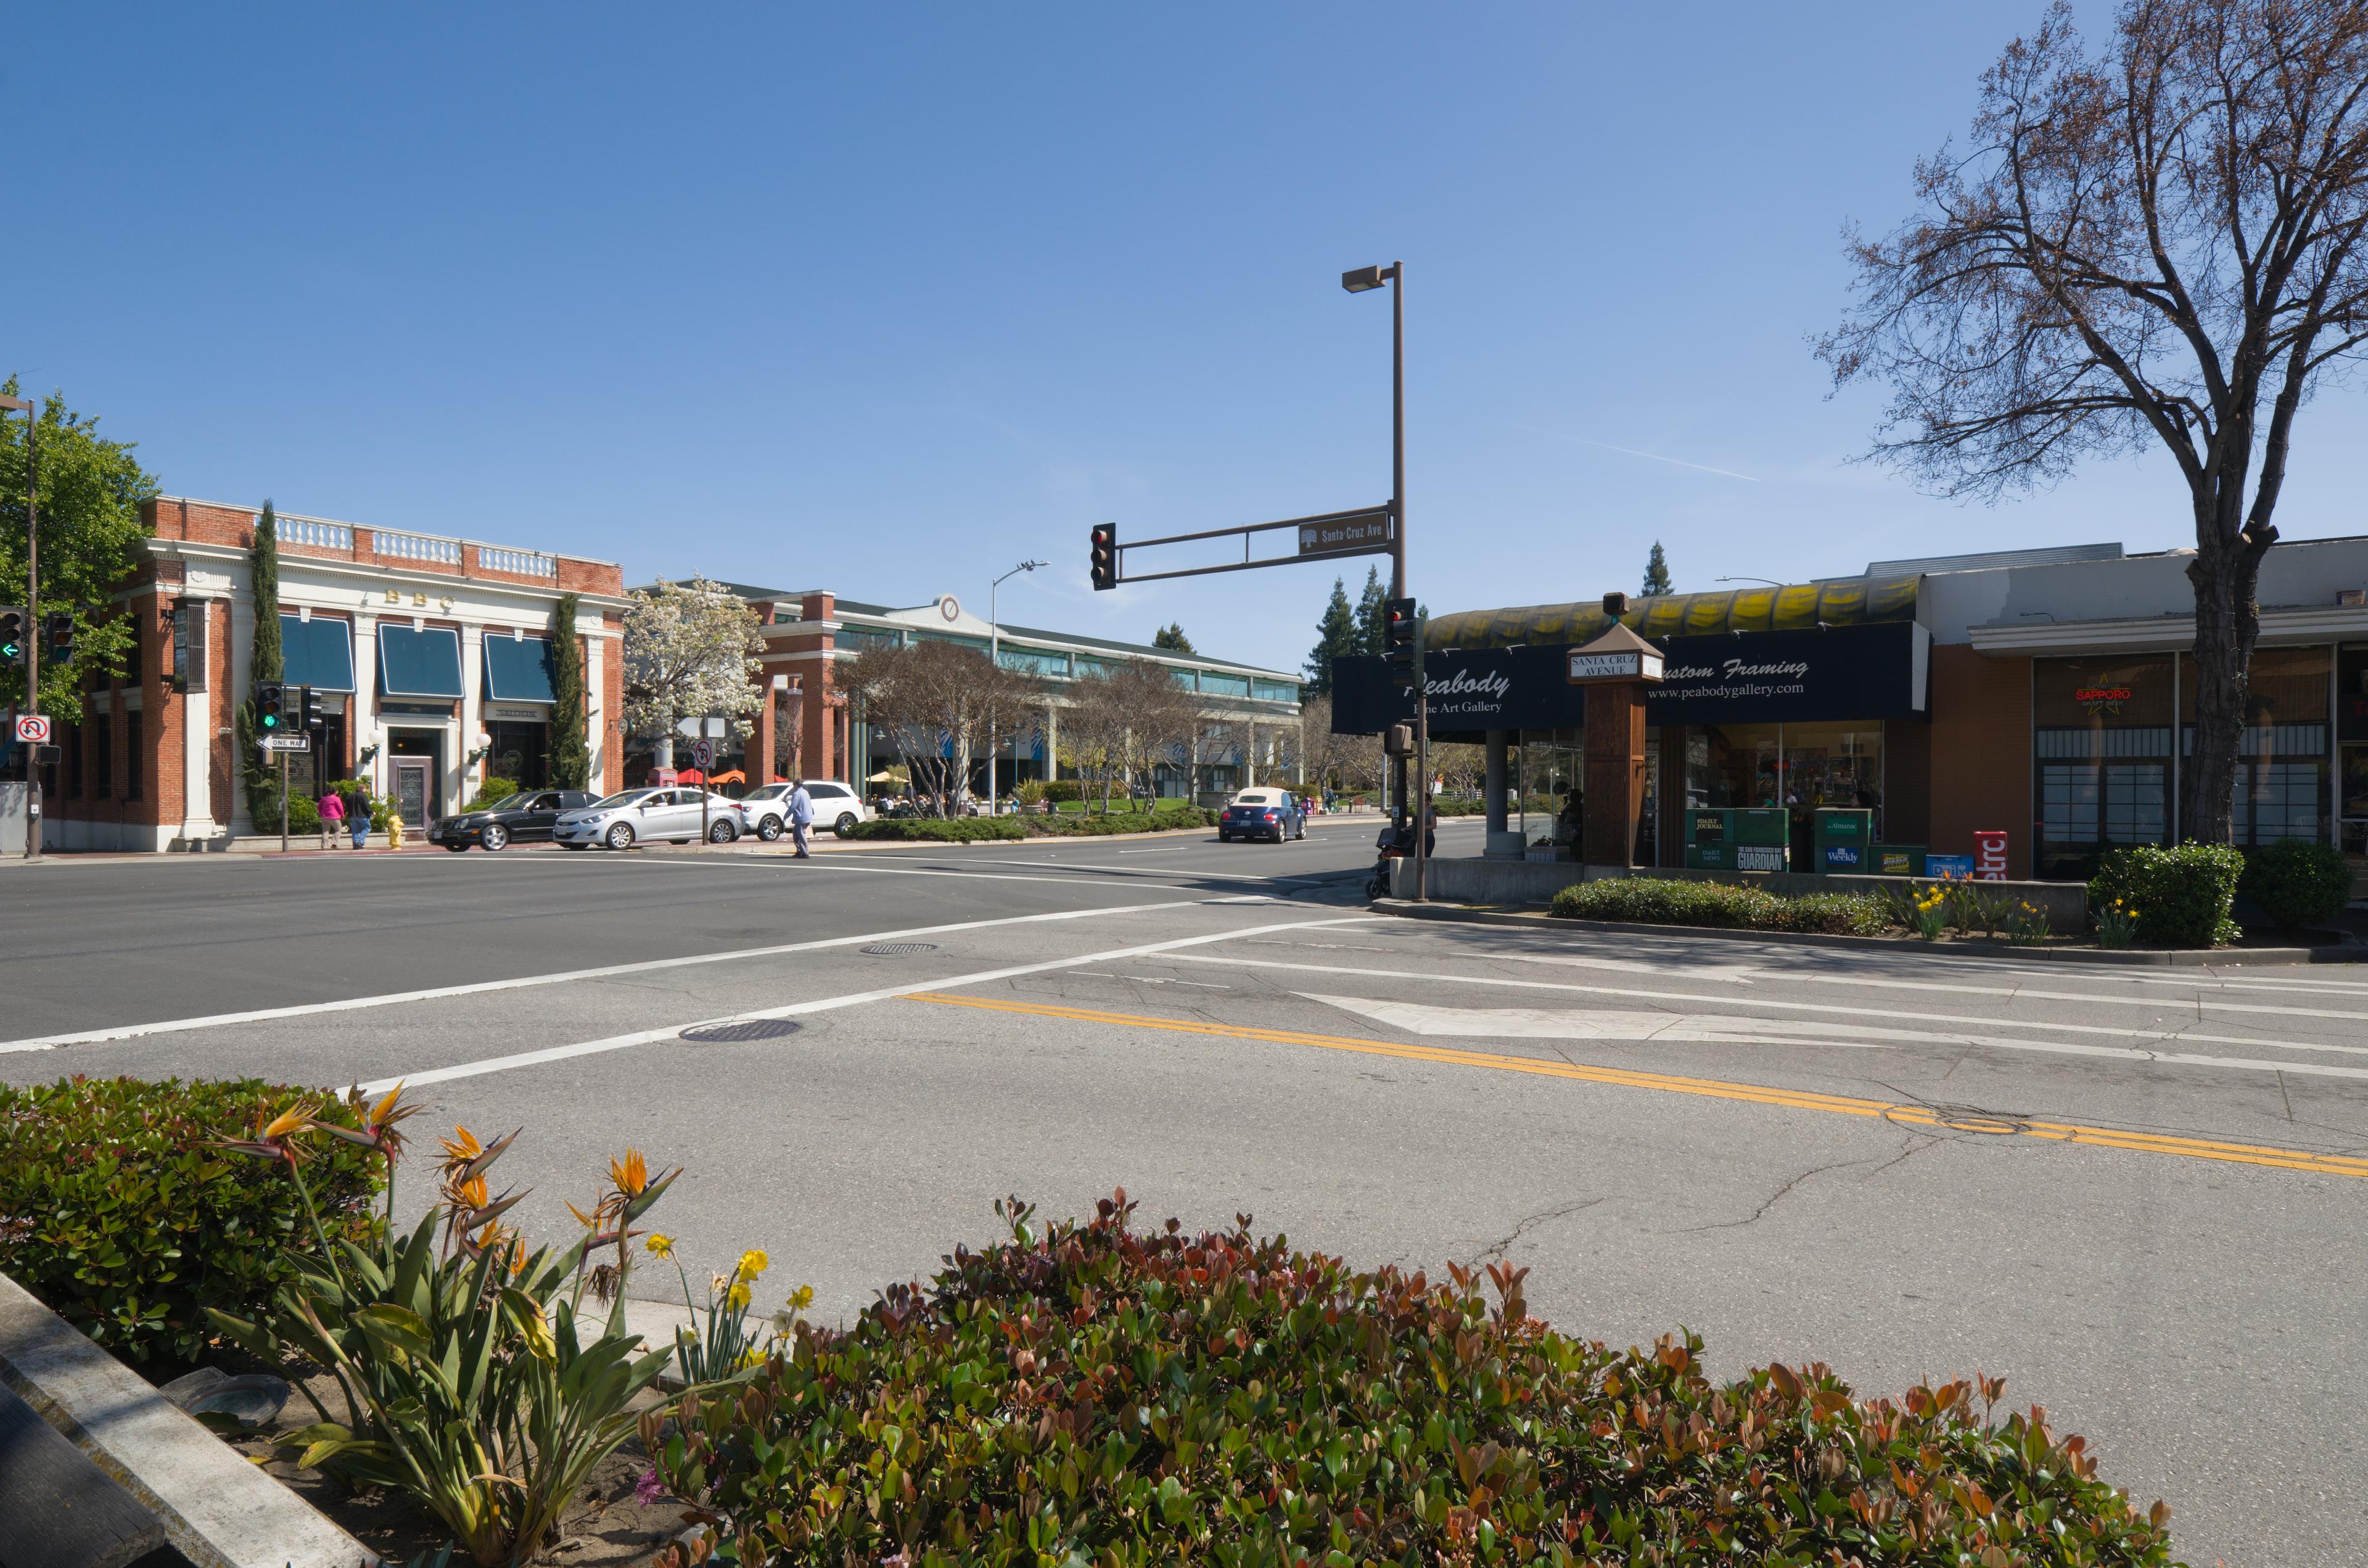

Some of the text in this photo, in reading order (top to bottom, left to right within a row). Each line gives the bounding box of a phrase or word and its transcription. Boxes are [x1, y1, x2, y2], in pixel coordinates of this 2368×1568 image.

[1322, 523, 1381, 543] Santa Cruz Ave
[1572, 655, 1637, 666] SANTA CRUZ
[1585, 666, 1626, 676] AVENUE
[1662, 658, 1809, 679] ustom Framing
[1648, 684, 1804, 700] www.peabodygallery.com
[2076, 690, 2131, 700] SAPPORO
[1440, 702, 1460, 713] Art
[1462, 701, 1502, 713] Gallery
[1737, 852, 1782, 871] GUARDIAN
[1827, 852, 1858, 864] Weekly
